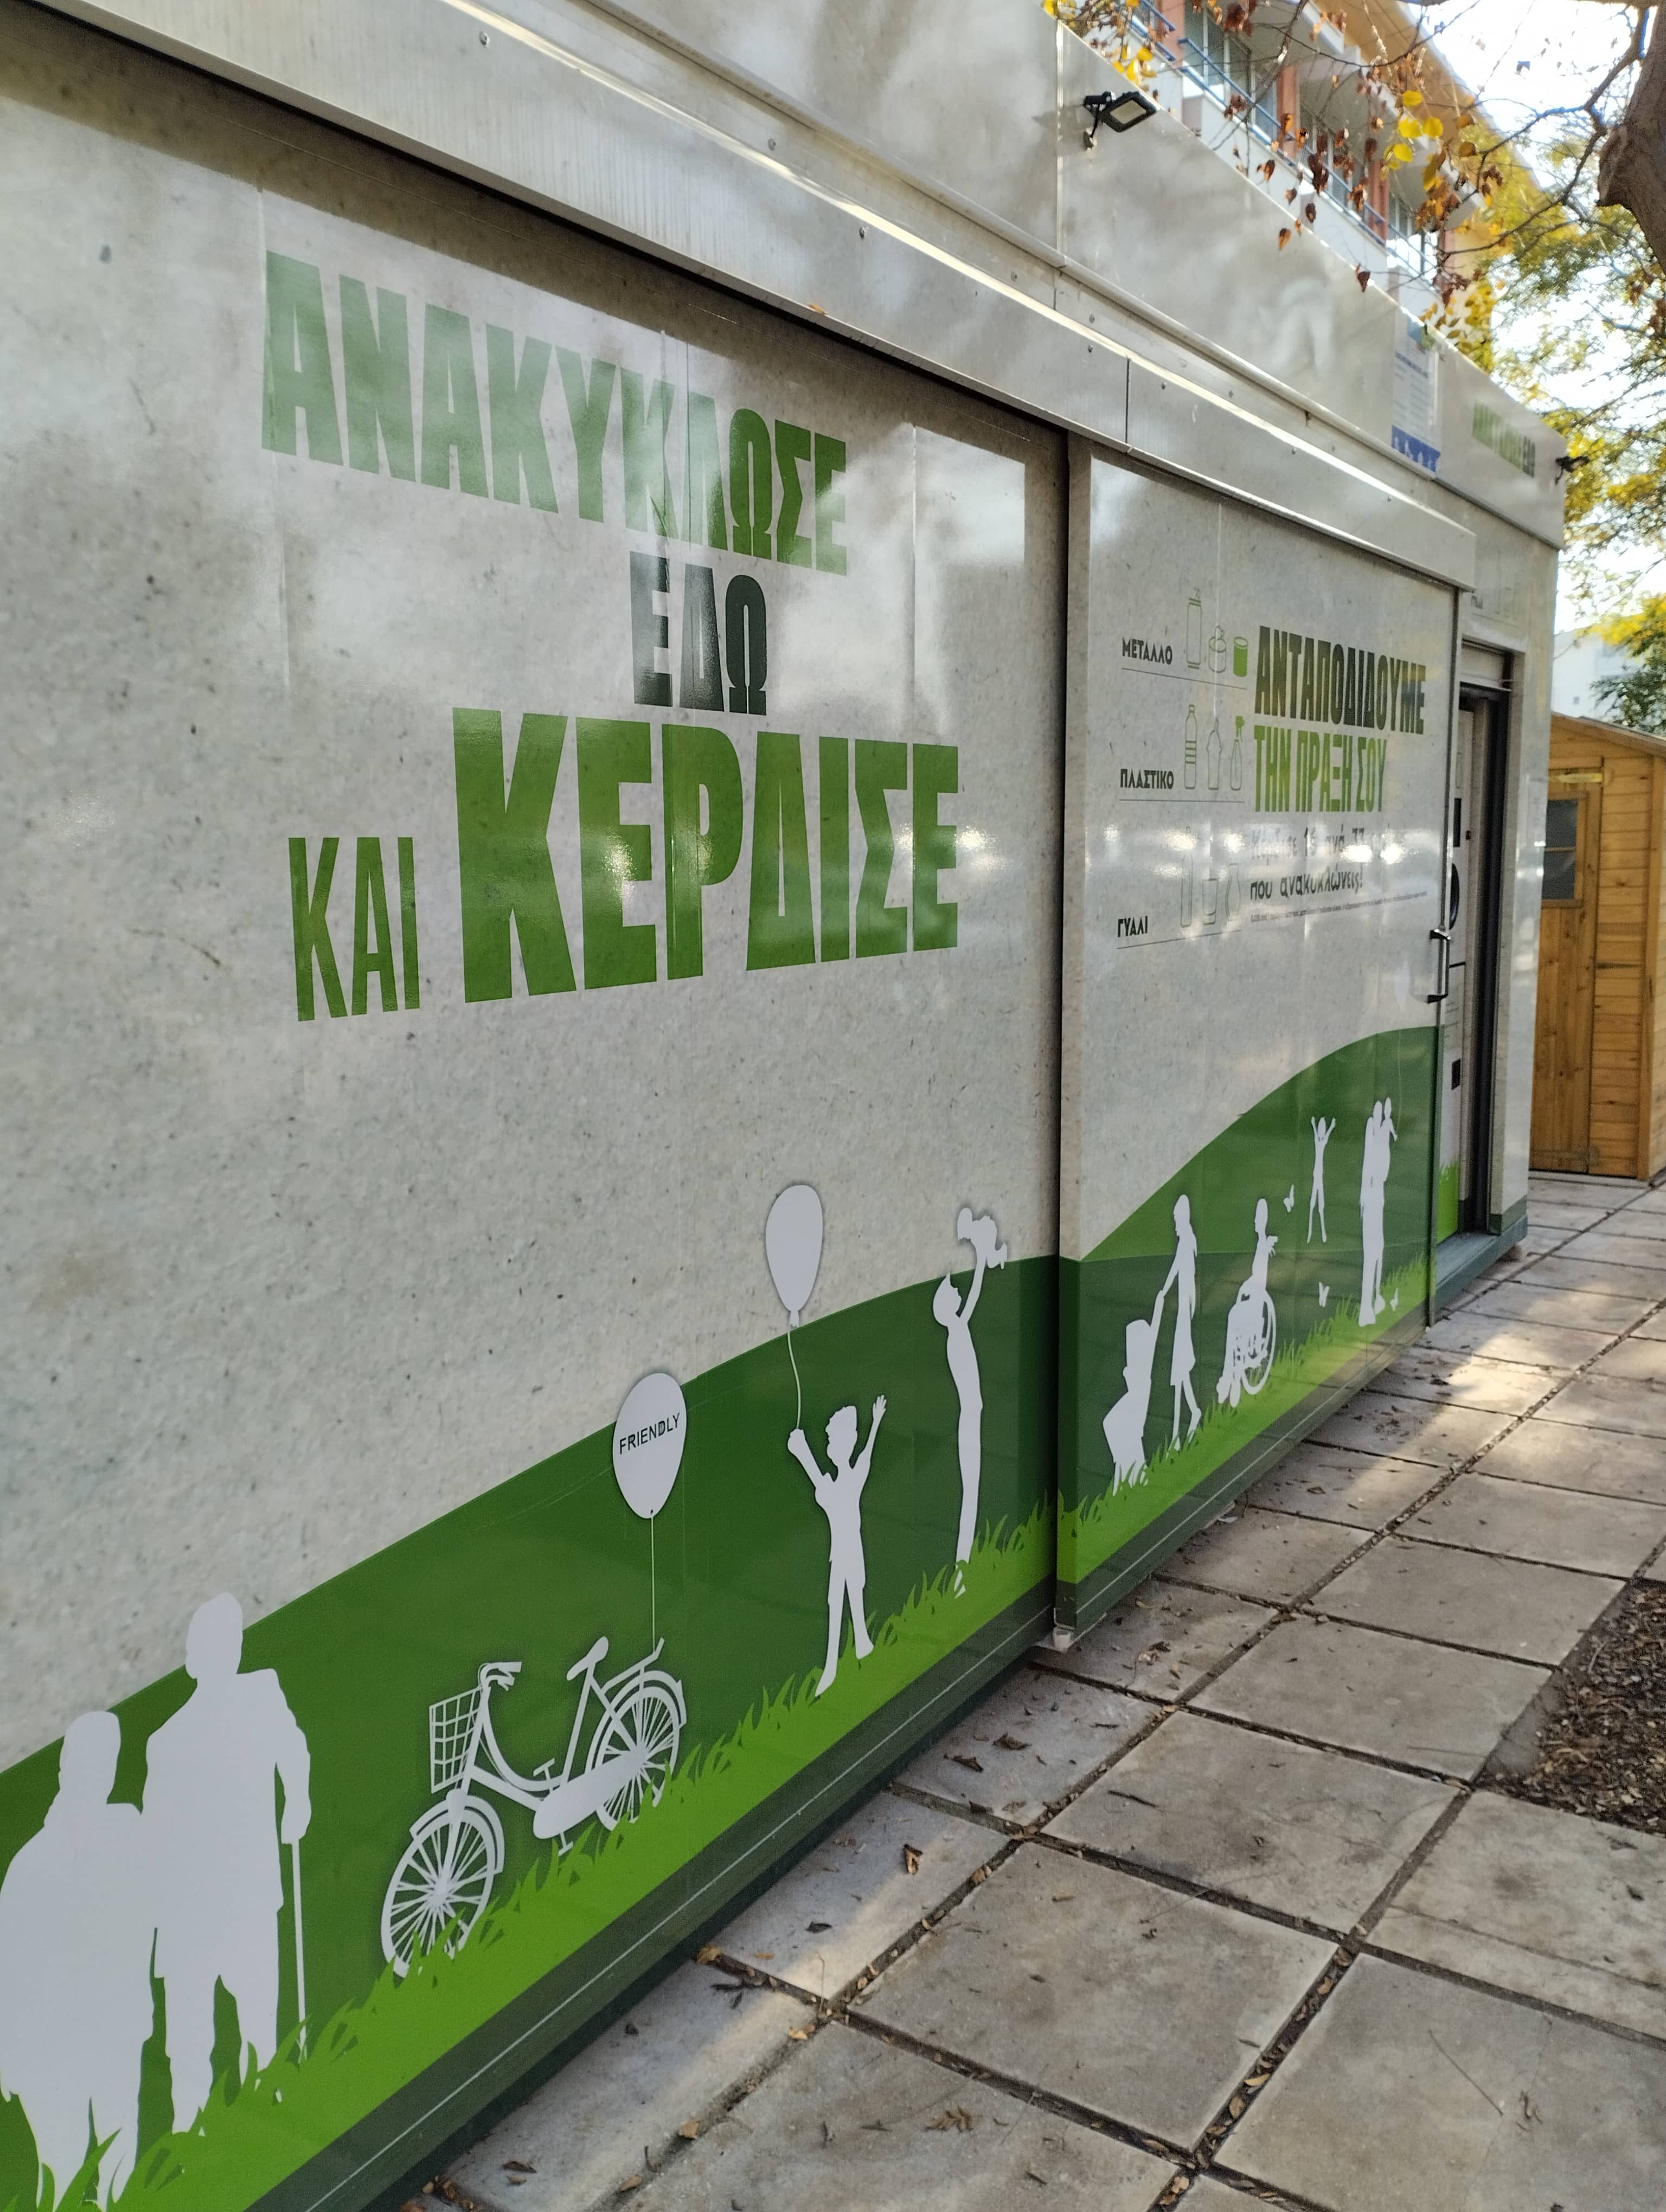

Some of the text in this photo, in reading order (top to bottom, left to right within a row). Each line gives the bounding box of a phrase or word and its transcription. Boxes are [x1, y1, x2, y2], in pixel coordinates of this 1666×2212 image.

[261, 250, 847, 576] ΑΝΑΚΥΚΛΩΣΕ
[629, 551, 767, 715] ΕΔΩ
[1122, 637, 1172, 665] ΜΕΤΑΛΛΟ
[1254, 625, 1426, 735] ΑΝΤΑΠΟΔΙΔΟΥΜΕ
[1120, 768, 1174, 789] ΠΛΑΣΤΙΚΟ
[1254, 725, 1387, 812] ΤΗΝ ΠΡΑΞΗ ΣΟΥ
[289, 708, 958, 1021] ΚΑΙ ΚΕΡΔΙΣΕ
[1250, 863, 1363, 901] που ανακυκλώνεις!
[1117, 916, 1148, 937] ΓΥΑΛΙ
[619, 1412, 680, 1455] FRIENDLY
